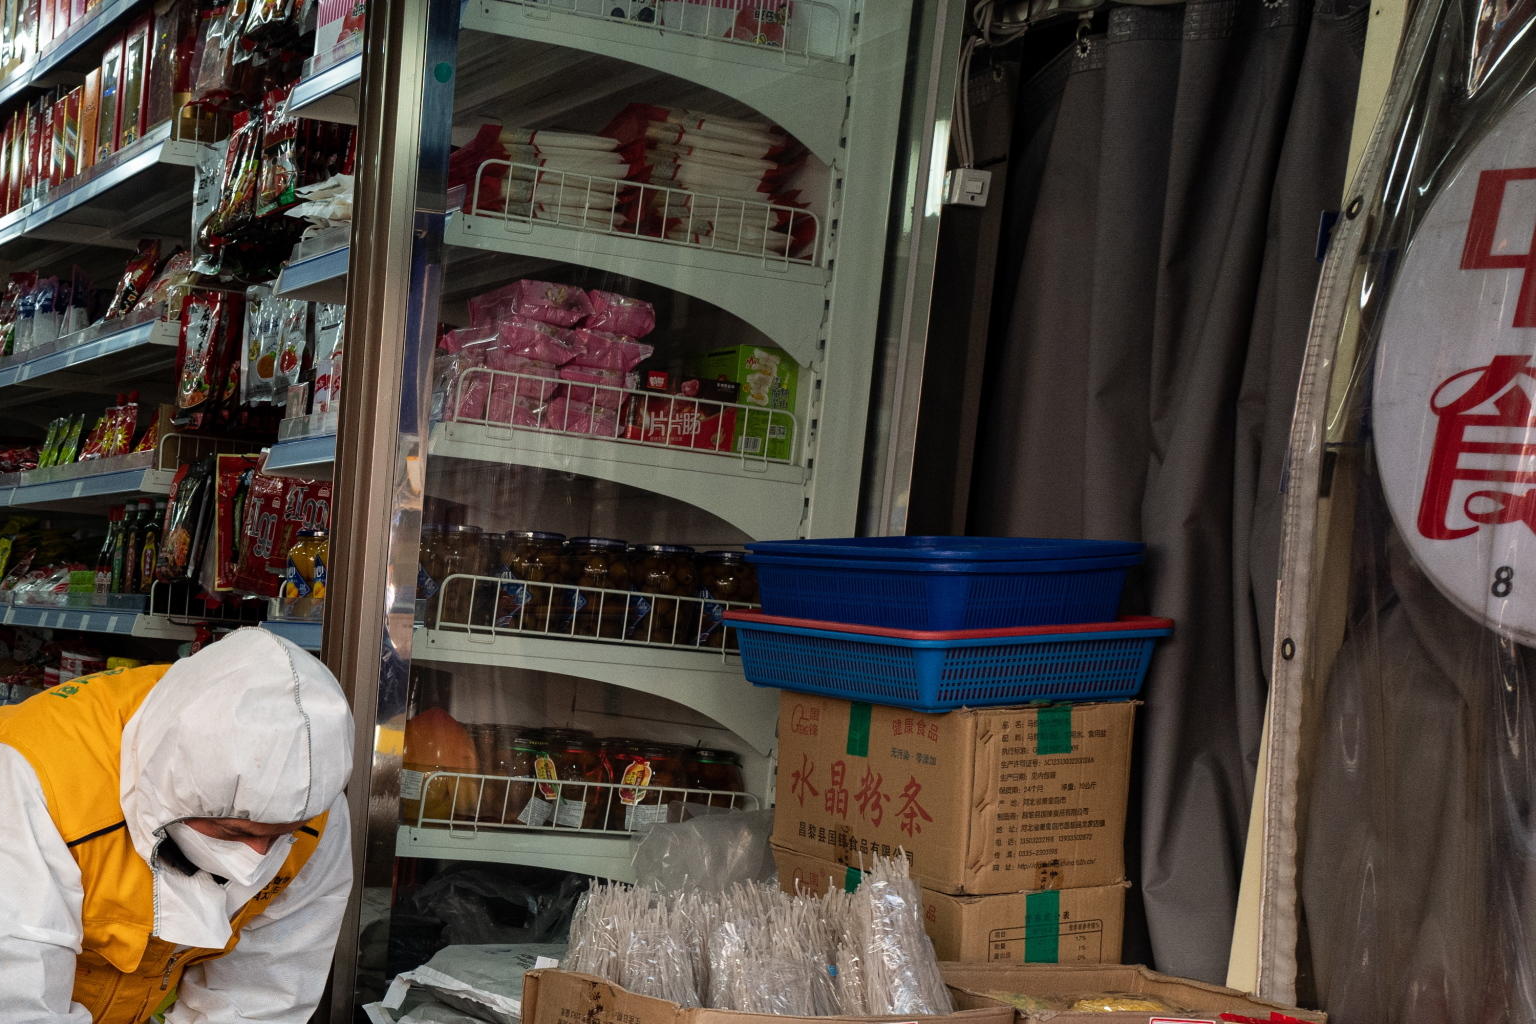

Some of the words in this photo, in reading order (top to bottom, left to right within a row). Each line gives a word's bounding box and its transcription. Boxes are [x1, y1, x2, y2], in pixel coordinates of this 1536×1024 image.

[891, 717, 940, 744] 健康食品
[791, 751, 934, 839] 水晶粉条
